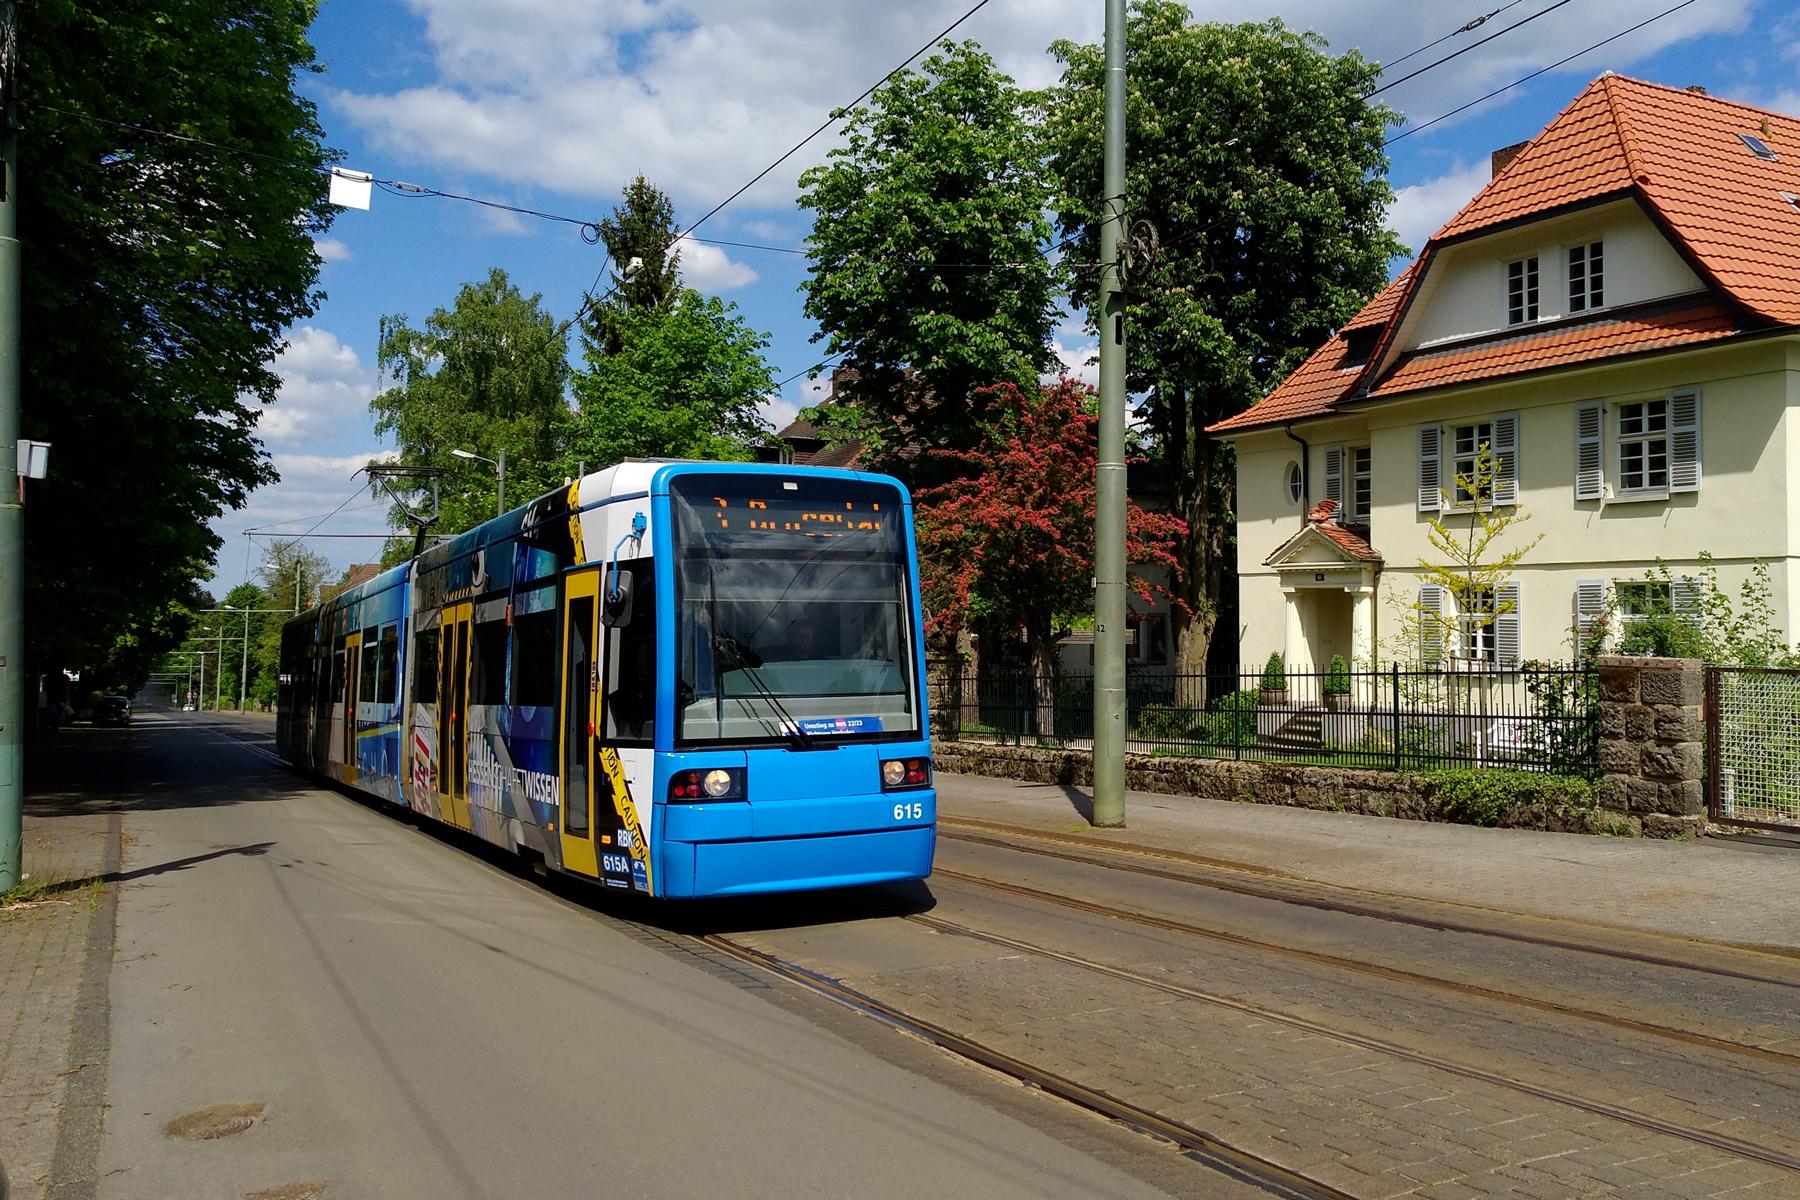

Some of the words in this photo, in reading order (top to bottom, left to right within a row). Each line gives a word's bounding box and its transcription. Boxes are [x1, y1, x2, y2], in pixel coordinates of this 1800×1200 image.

[804, 722, 827, 730] Umstieg
[893, 803, 922, 820] 615
[620, 795, 646, 860] CAUTION
[617, 828, 635, 848] RBK
[603, 855, 629, 873] 615A
